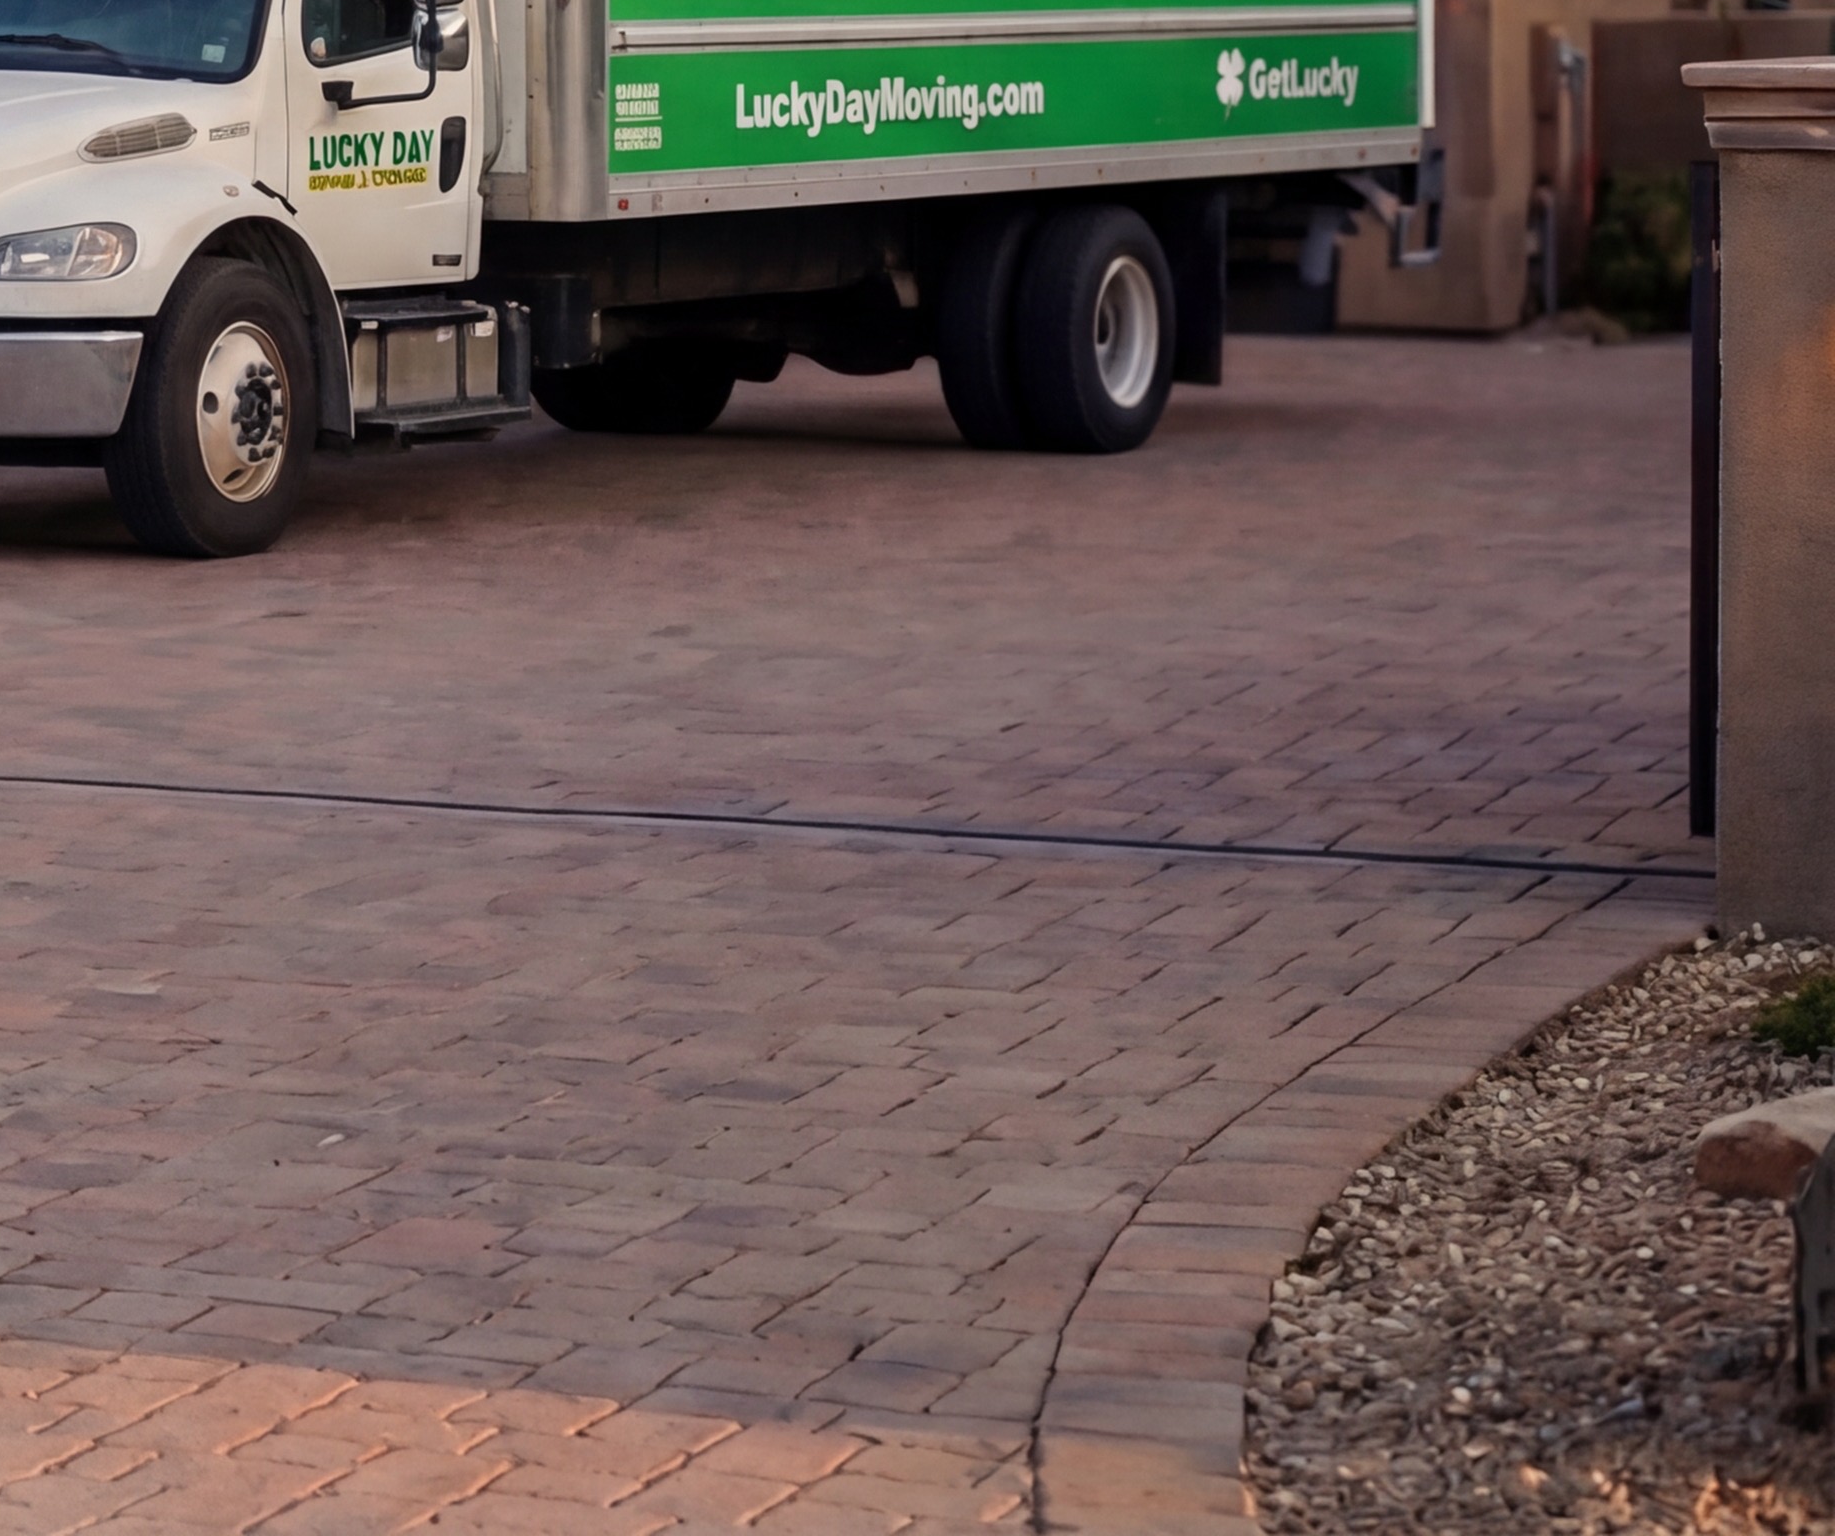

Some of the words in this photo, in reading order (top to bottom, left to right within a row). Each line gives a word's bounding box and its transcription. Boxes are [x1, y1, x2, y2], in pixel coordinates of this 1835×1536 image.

[735, 75, 1045, 138] LuckyDayMoving.com
[1248, 55, 1359, 107] GetLucky
[309, 131, 385, 171] LUCKY
[392, 129, 434, 166] DAY
